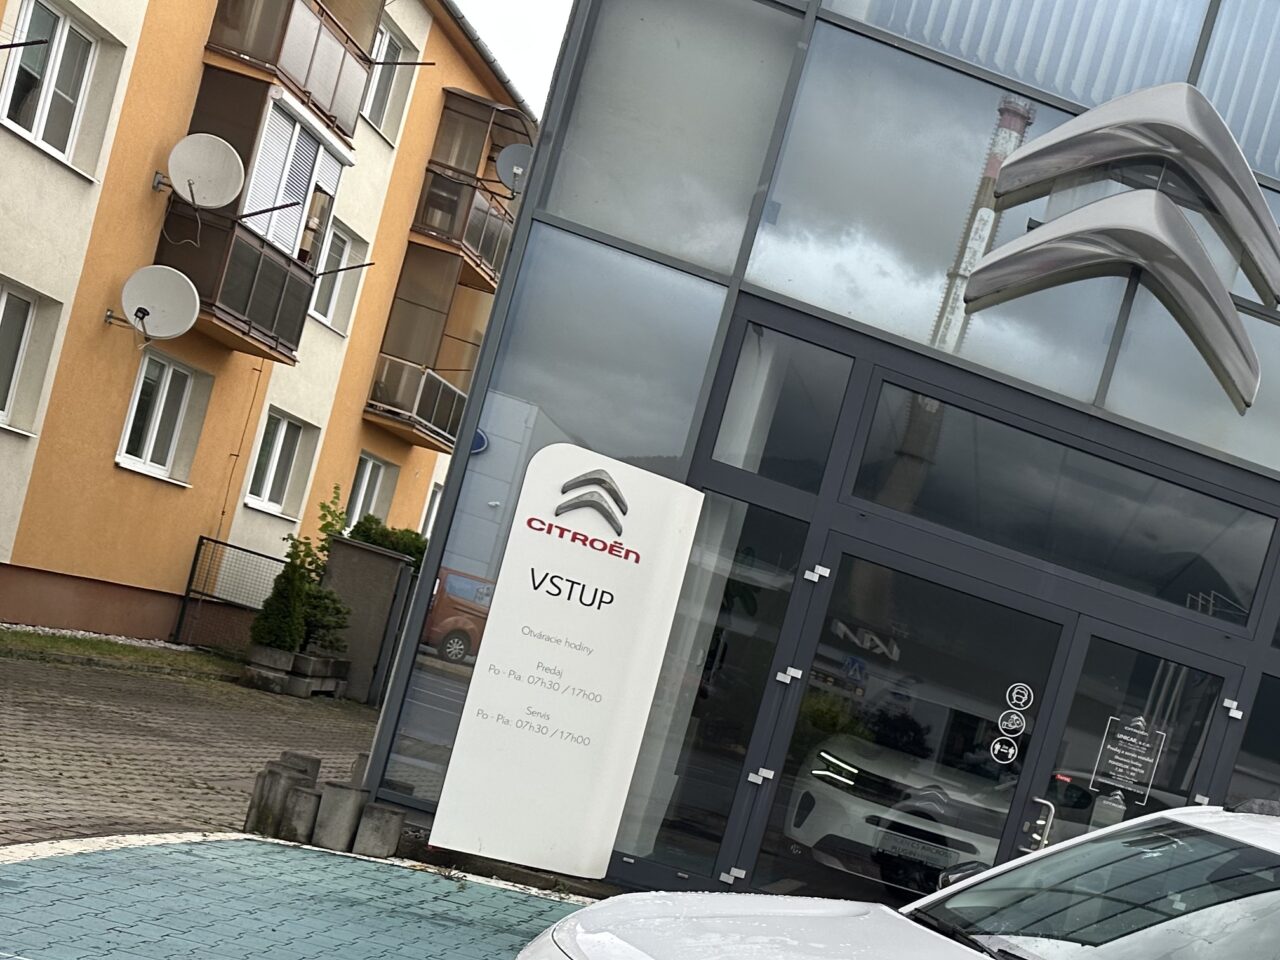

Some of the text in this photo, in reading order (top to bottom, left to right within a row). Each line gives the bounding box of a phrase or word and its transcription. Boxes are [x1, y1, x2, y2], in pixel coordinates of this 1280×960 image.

[526, 517, 640, 564] CITROËN
[530, 567, 614, 610] VSTUP
[521, 625, 594, 656] Otváracie hodiny
[488, 664, 501, 676] Po
[527, 675, 560, 692] 07h30
[571, 687, 603, 703] 17h00
[536, 661, 563, 679] Predaj
[476, 708, 489, 720] Po
[515, 719, 549, 736] 07h30
[559, 730, 591, 746] 17h00
[525, 706, 550, 721] Servis
